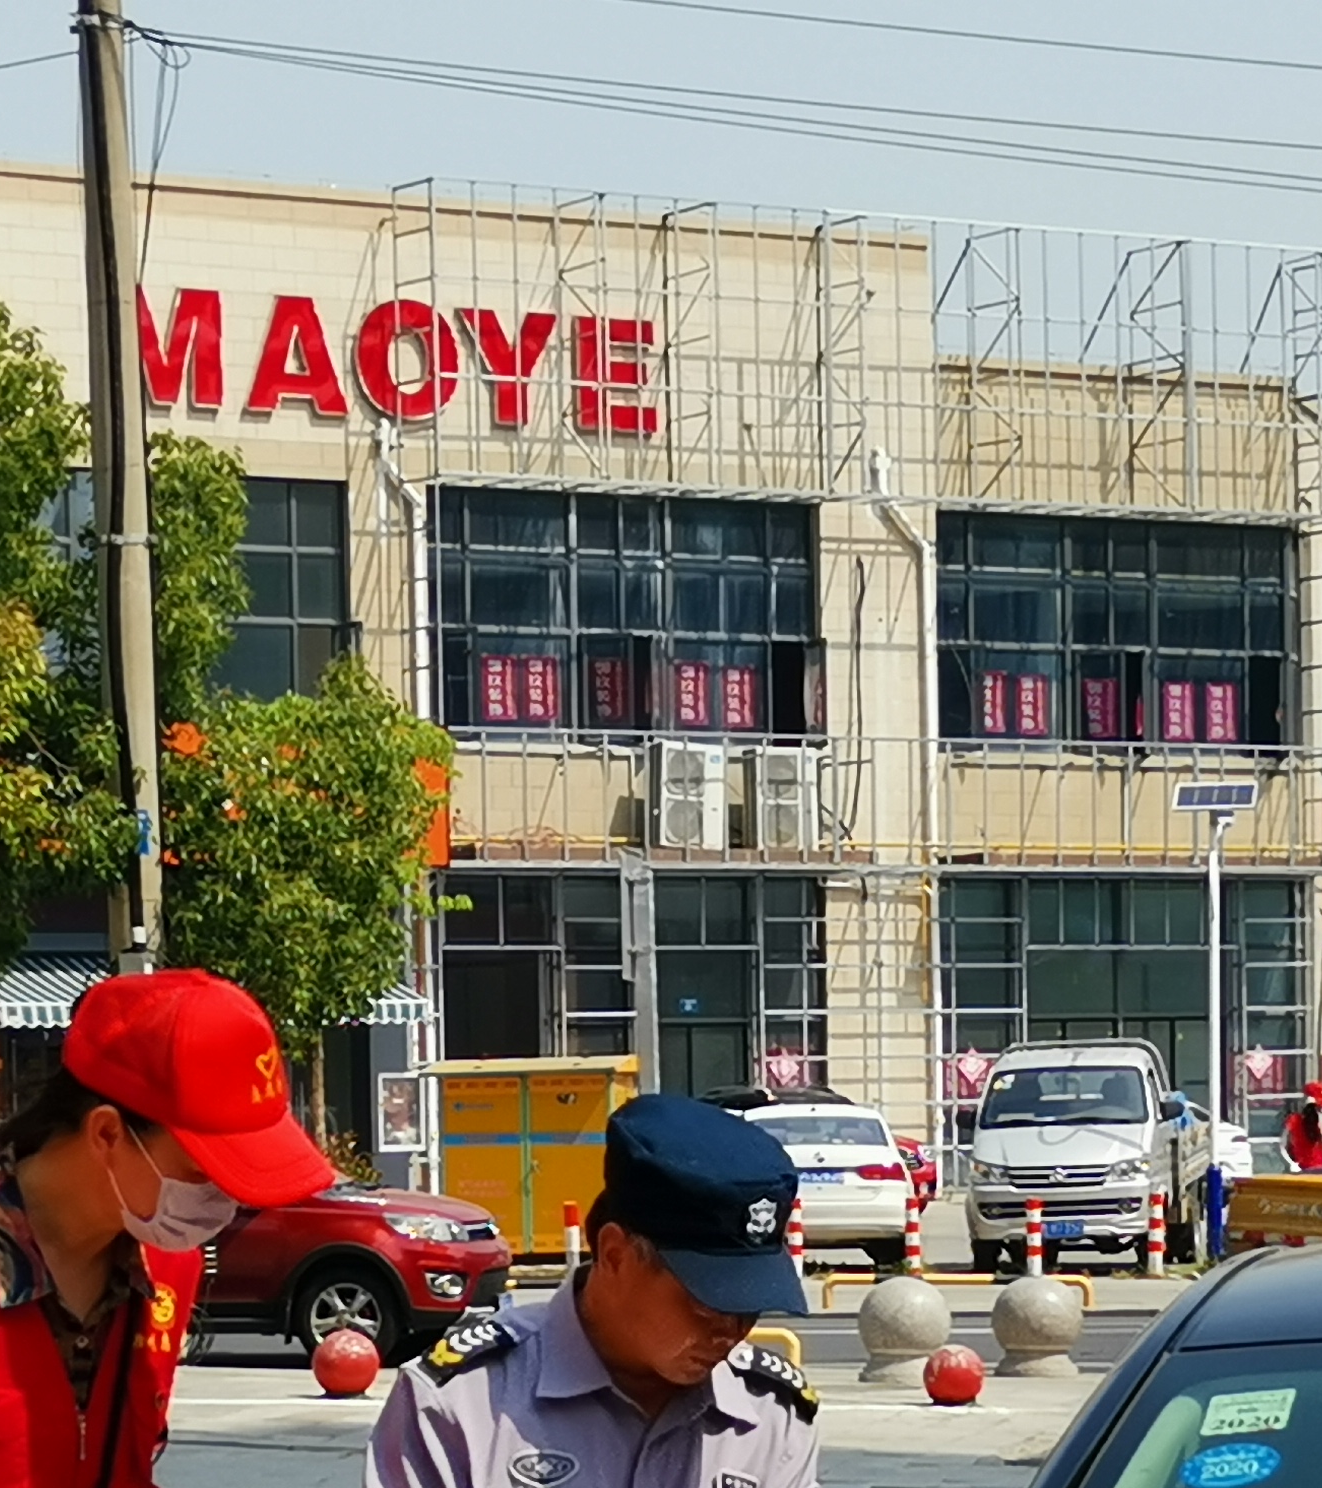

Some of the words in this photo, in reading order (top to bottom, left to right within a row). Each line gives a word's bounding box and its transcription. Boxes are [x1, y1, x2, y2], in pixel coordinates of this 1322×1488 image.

[136, 285, 657, 433] MAOYE
[1210, 1415, 1281, 1430] 2020
[1201, 1459, 1259, 1479] 2020
